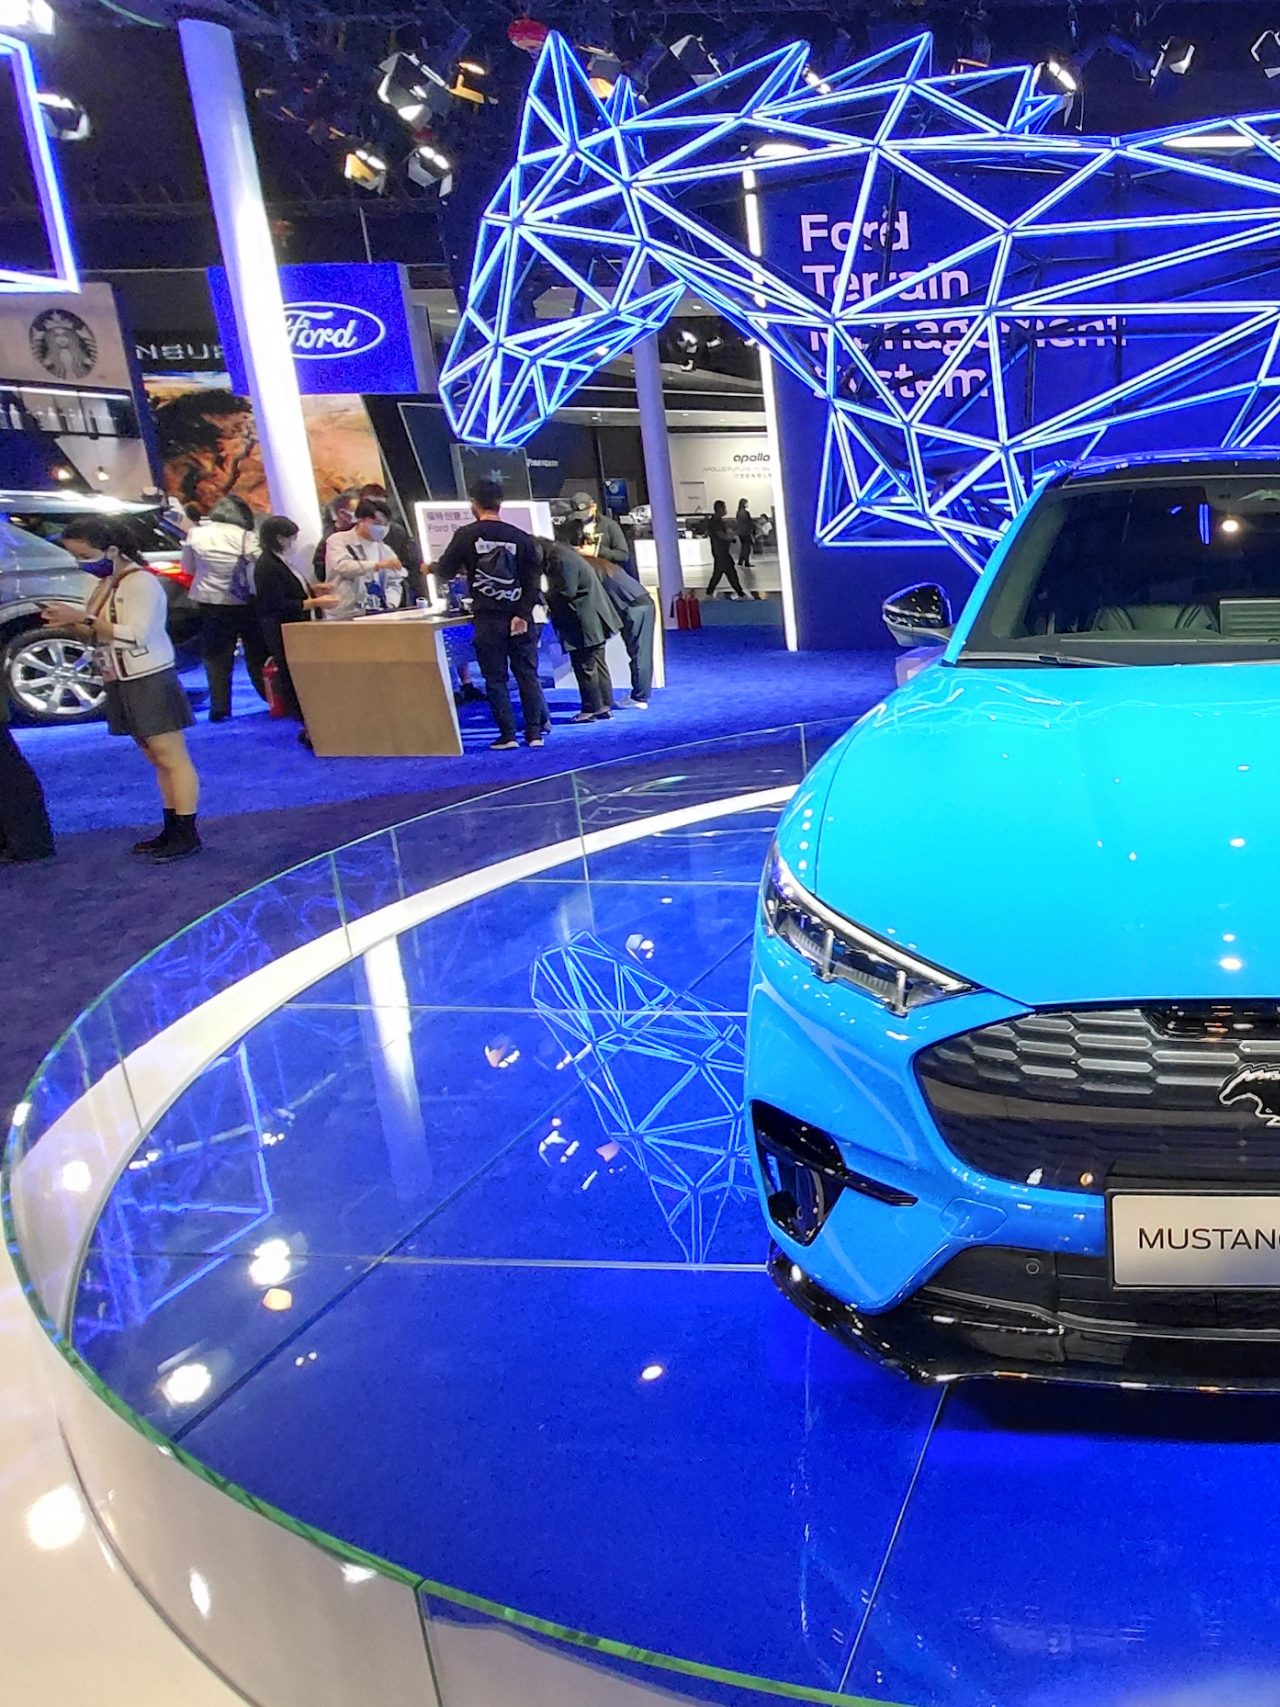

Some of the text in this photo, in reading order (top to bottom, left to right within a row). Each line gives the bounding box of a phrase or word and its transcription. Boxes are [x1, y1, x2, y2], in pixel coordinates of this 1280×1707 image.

[801, 211, 910, 252] Ford
[802, 262, 969, 302] Terain
[813, 363, 988, 400] stem
[733, 453, 771, 464] apollo
